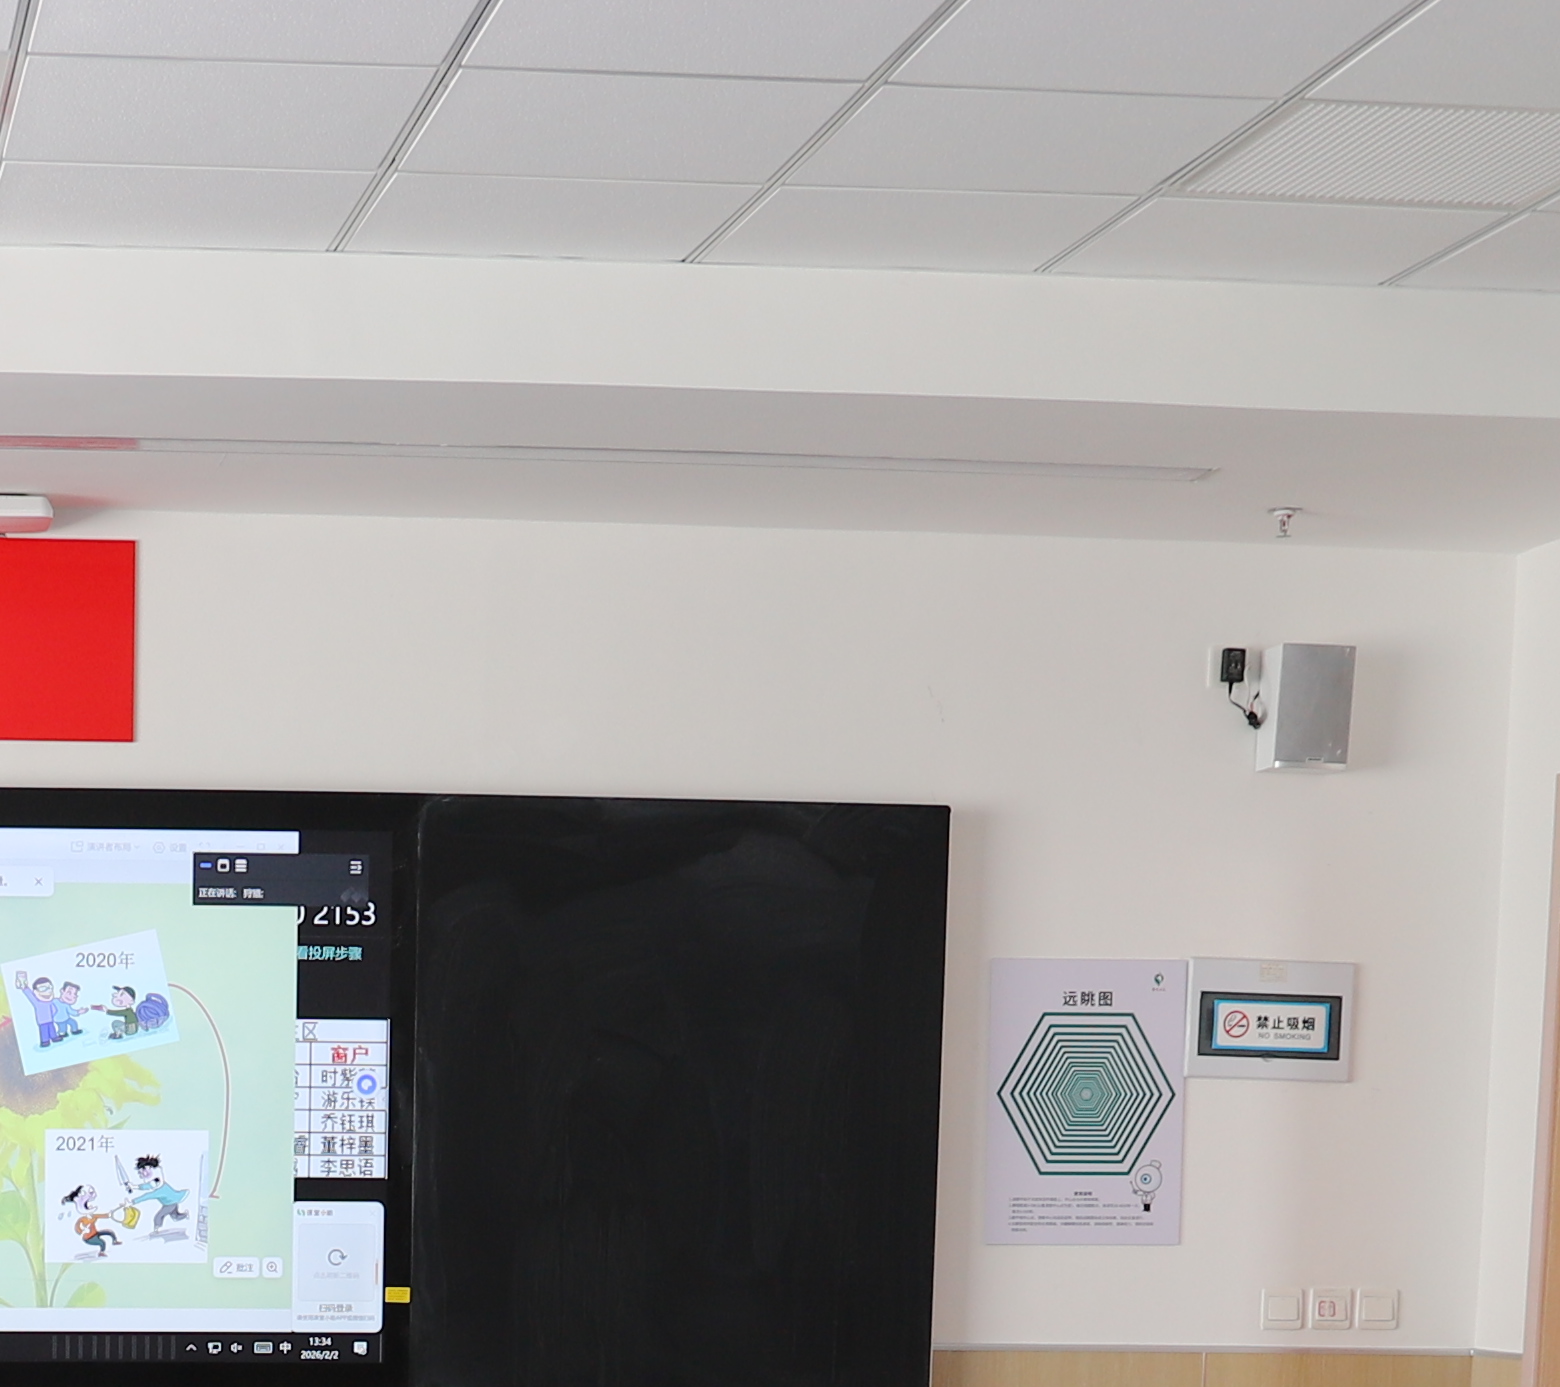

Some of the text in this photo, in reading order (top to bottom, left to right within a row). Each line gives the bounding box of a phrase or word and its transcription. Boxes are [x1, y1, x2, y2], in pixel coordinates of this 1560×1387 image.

[75, 951, 135, 969] 2020年
[1062, 991, 1114, 1007] 远眺图
[1256, 1015, 1315, 1031] 禁止吸烟
[1258, 1032, 1311, 1041] NO SMOKING
[321, 1067, 376, 1087] 时紫
[56, 1135, 115, 1153] 2021年
[321, 1136, 374, 1155] 董梓墨
[320, 1158, 374, 1177] 李思语
[280, 1341, 292, 1354] 中
[308, 1337, 332, 1346] 13:34
[301, 1350, 339, 1360] 2026/2/2
